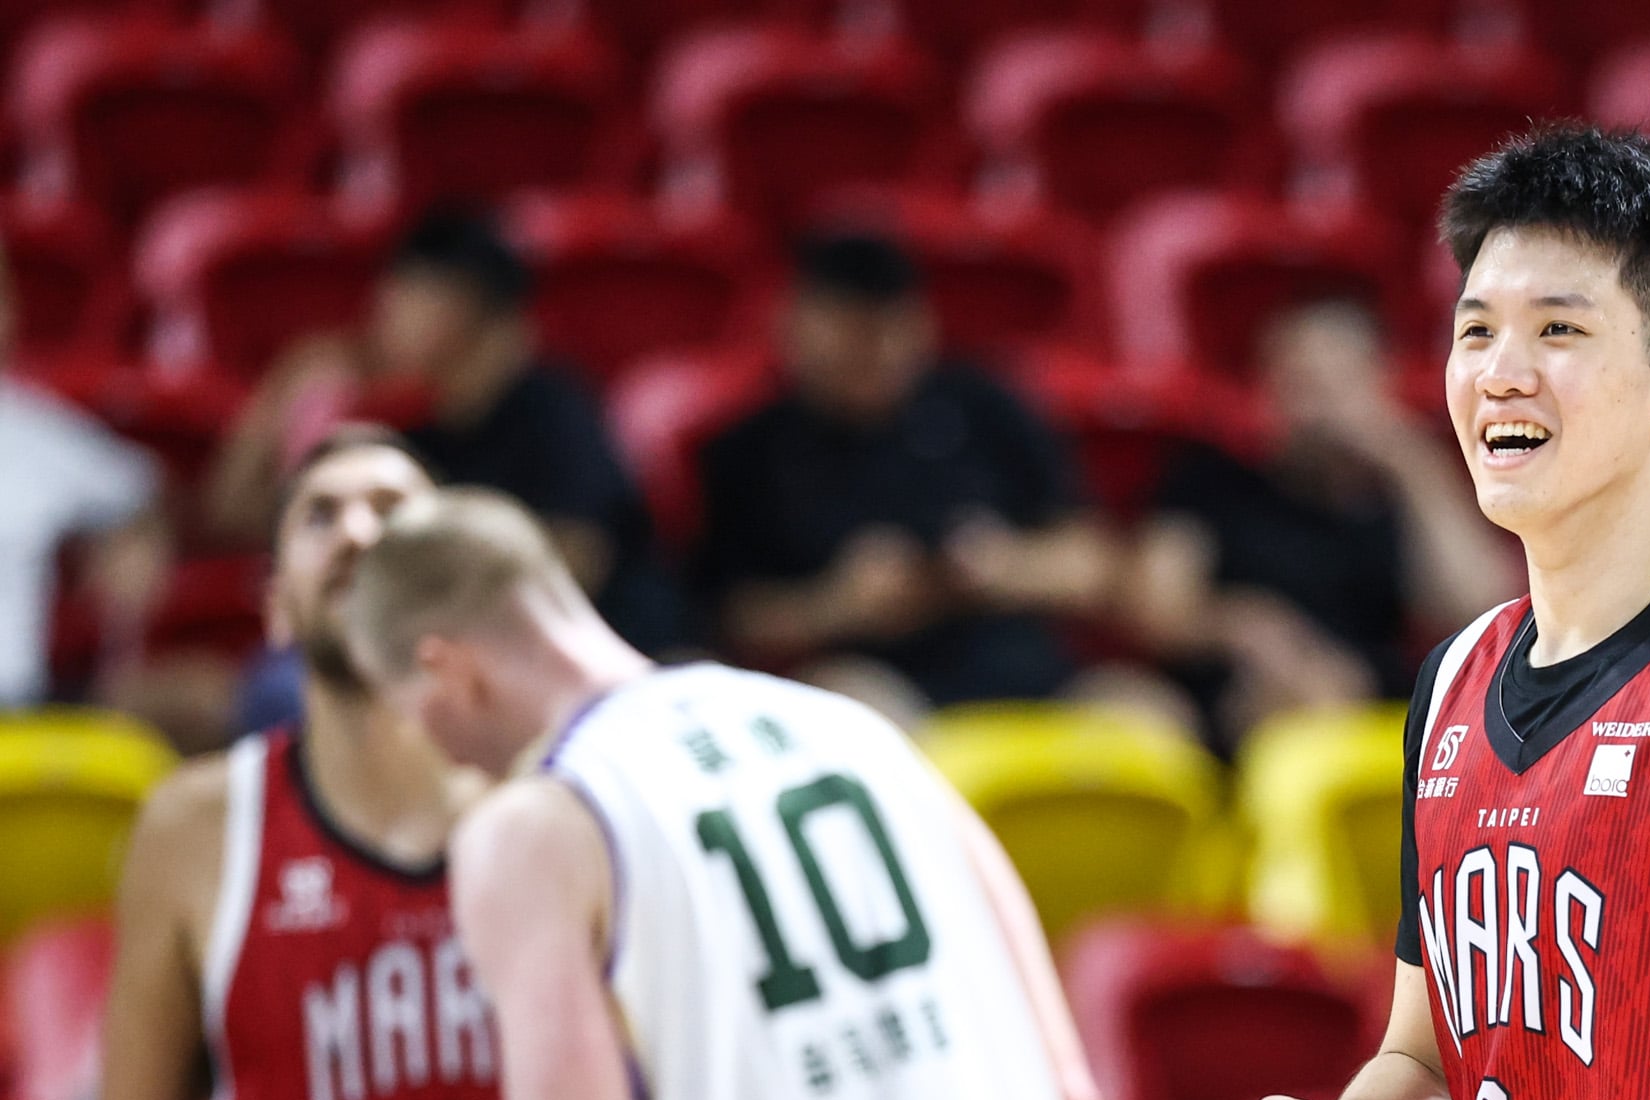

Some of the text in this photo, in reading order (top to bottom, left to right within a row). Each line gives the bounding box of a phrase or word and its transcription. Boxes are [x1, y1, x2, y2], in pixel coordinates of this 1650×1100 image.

[696, 773, 931, 1014] 10
[1477, 807, 1540, 828] TAIPEI
[1418, 841, 1606, 1068] MARS
